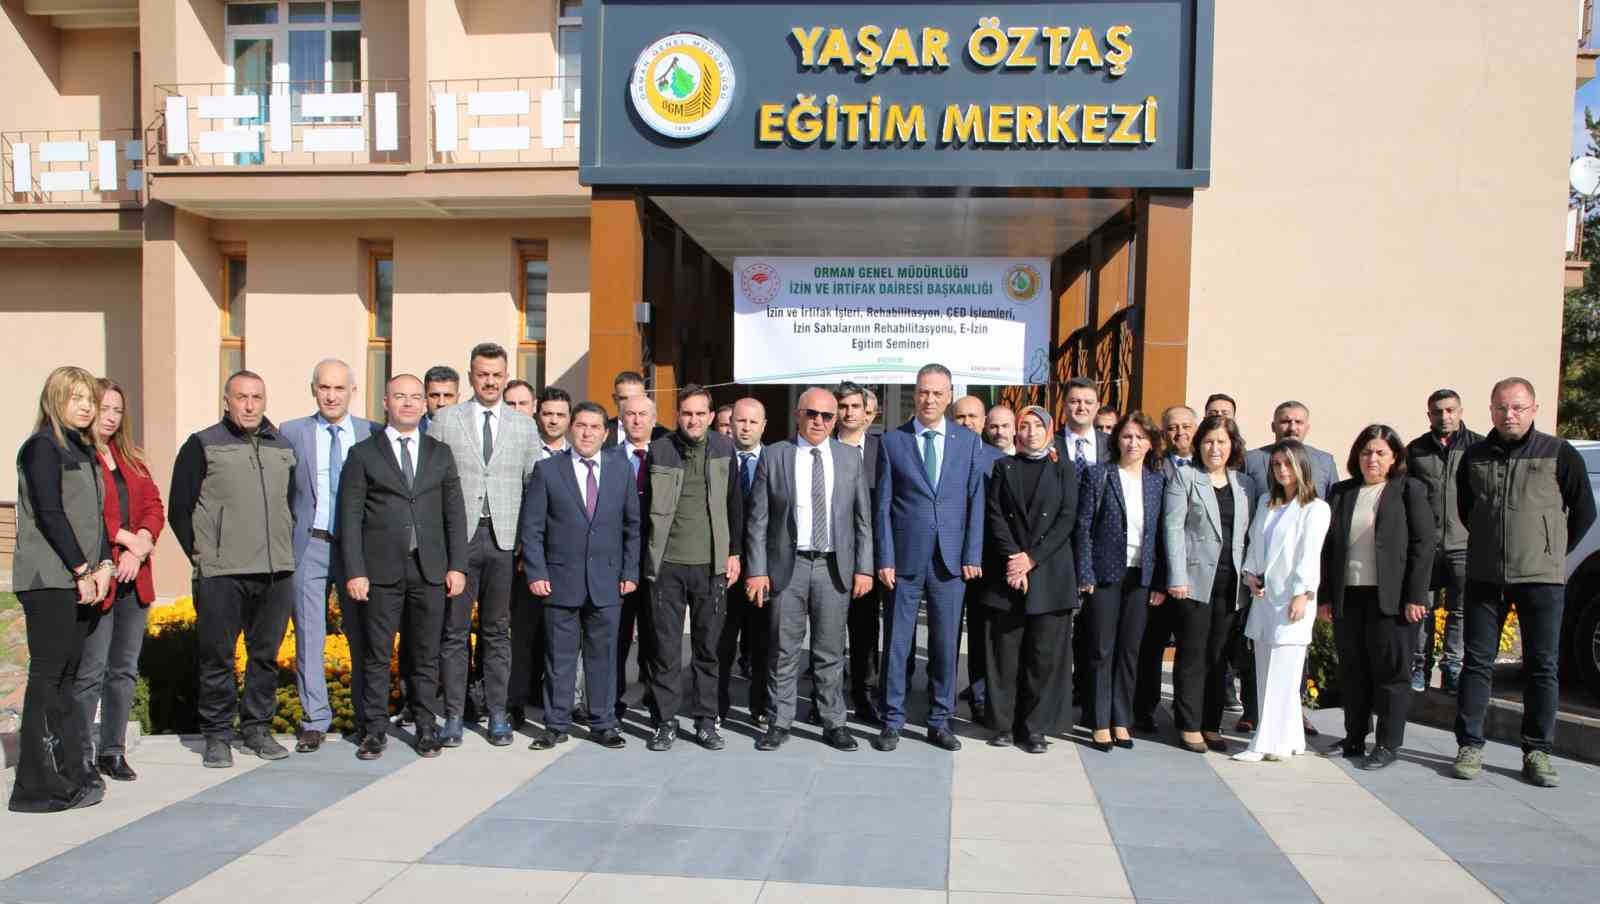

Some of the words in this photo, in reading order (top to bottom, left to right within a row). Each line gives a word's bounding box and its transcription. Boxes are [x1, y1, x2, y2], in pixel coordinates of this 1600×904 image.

[791, 24, 951, 76] YAŞAR
[968, 16, 1133, 76] ÖZTAŞ
[662, 100, 684, 117] OGM
[758, 93, 928, 143] EĞİTİM
[942, 95, 1159, 144] MERKEZİ
[814, 267, 855, 278] ORMAN
[858, 267, 894, 278] GENEL
[897, 264, 969, 279] MÜDÜRLÜĞÜ
[789, 280, 812, 294] İZİN
[815, 283, 829, 294] VE
[833, 280, 876, 294] İRTİFAK
[879, 280, 923, 294] DAİRESİ
[927, 281, 993, 297] BAŞKANLIĞI
[767, 305, 784, 318] İzin
[786, 308, 798, 318] ve
[801, 305, 832, 318] İrtifak
[835, 305, 863, 320] İşleri,
[866, 307, 943, 321] Rehabilitasyon,
[946, 307, 967, 319] ÇED
[969, 305, 1016, 321] İşlemleri,
[793, 322, 811, 334] İzin
[814, 322, 871, 334] Sahalarının
[874, 323, 957, 336] Rehabilitasyonu,
[960, 323, 988, 334] E-İzin
[852, 338, 883, 351] Eğitim
[886, 338, 930, 350] Semineri
